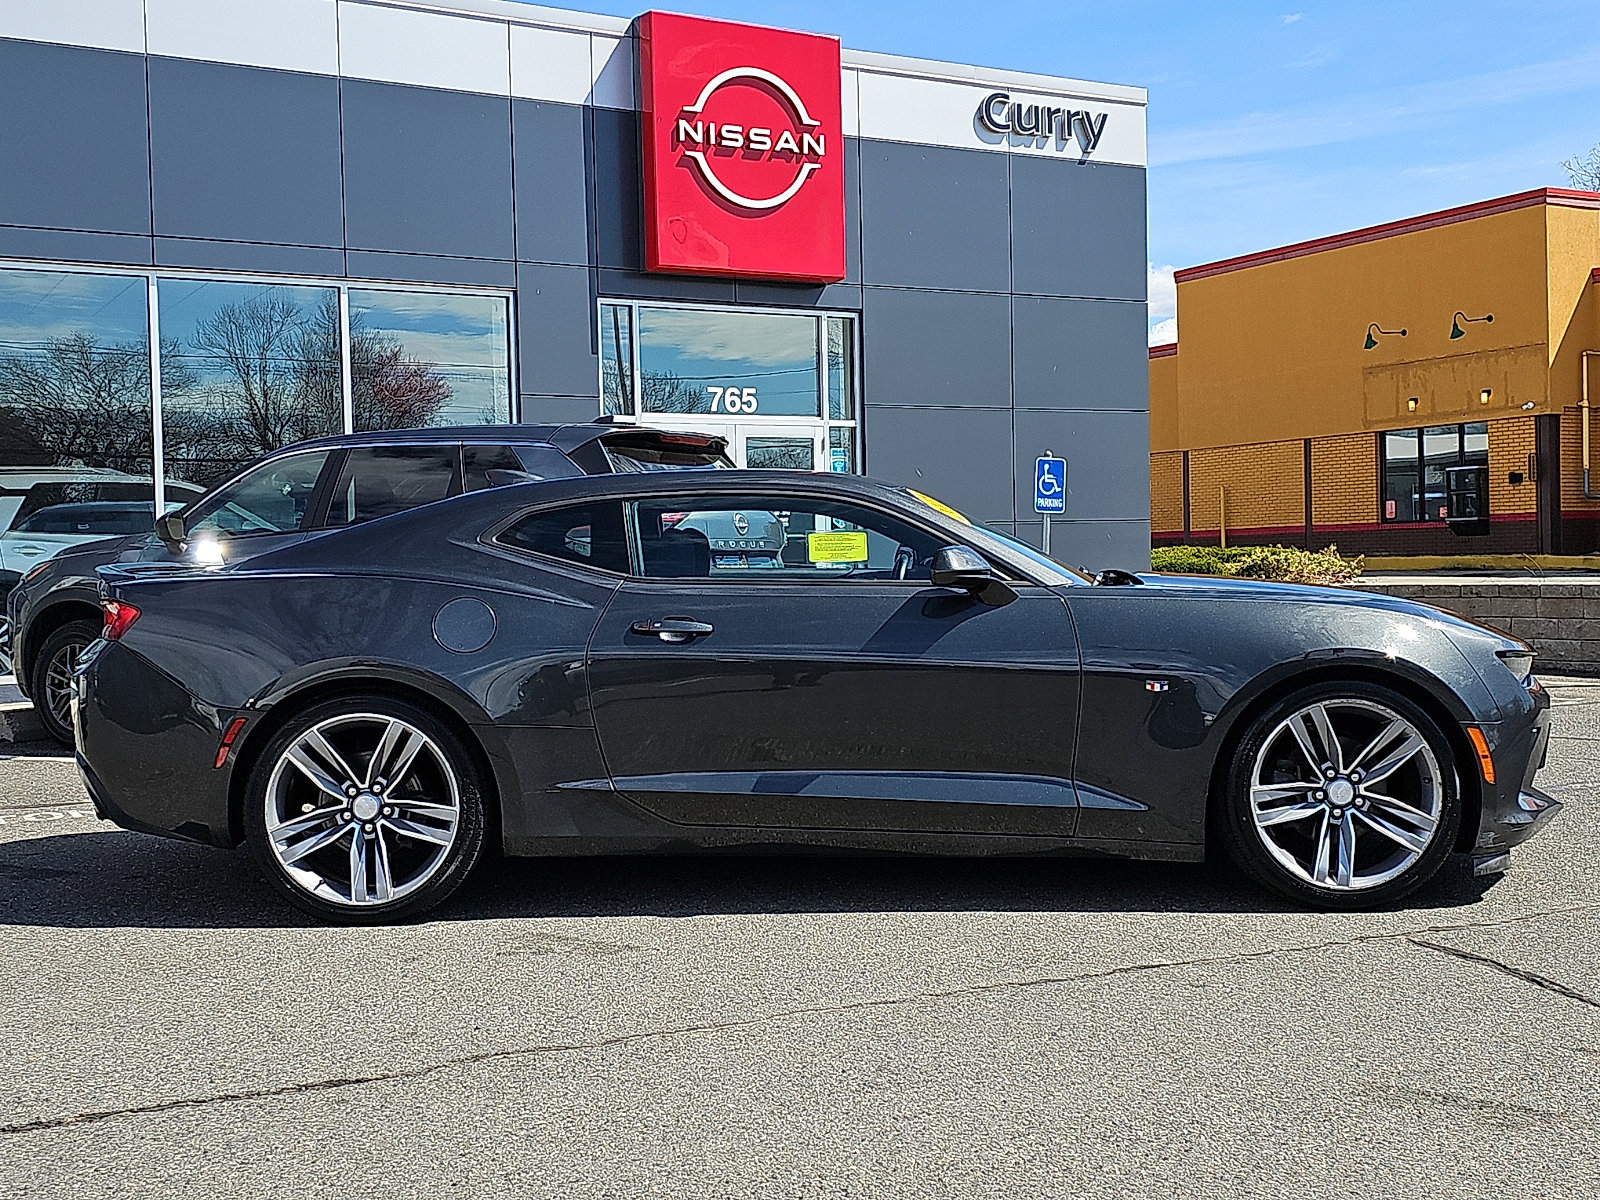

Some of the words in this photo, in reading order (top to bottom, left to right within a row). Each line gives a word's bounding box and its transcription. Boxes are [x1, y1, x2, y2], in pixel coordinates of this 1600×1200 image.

[678, 118, 826, 156] NISSAN
[981, 92, 1109, 151] Curry
[706, 386, 758, 414] 765
[1037, 497, 1063, 508] PARKING
